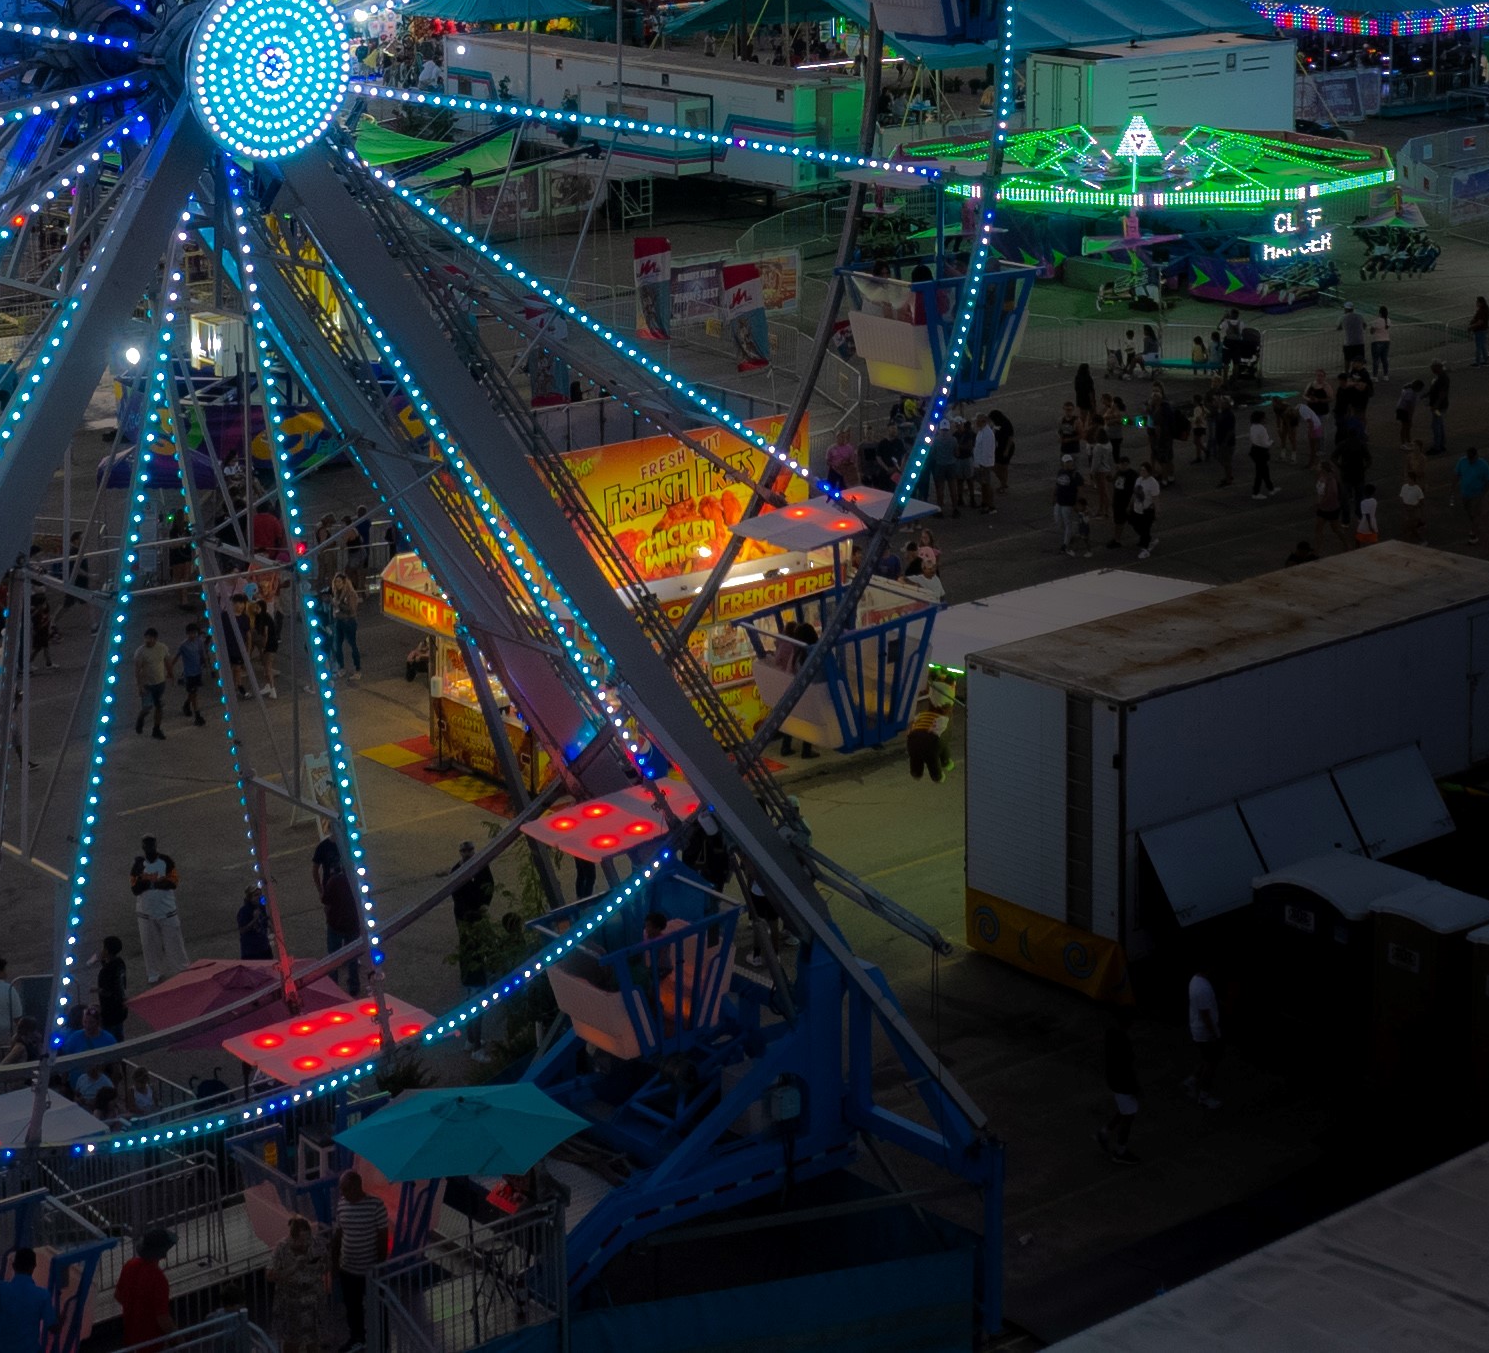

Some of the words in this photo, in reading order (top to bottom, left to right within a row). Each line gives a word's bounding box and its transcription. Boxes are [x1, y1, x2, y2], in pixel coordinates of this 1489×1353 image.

[640, 447, 687, 481] FRESH
[603, 468, 692, 527] FRENCH
[635, 518, 716, 564] CHICKEN
[644, 537, 710, 574] WINGS
[384, 585, 439, 627] FRENCH
[719, 581, 788, 616] FRENCH
